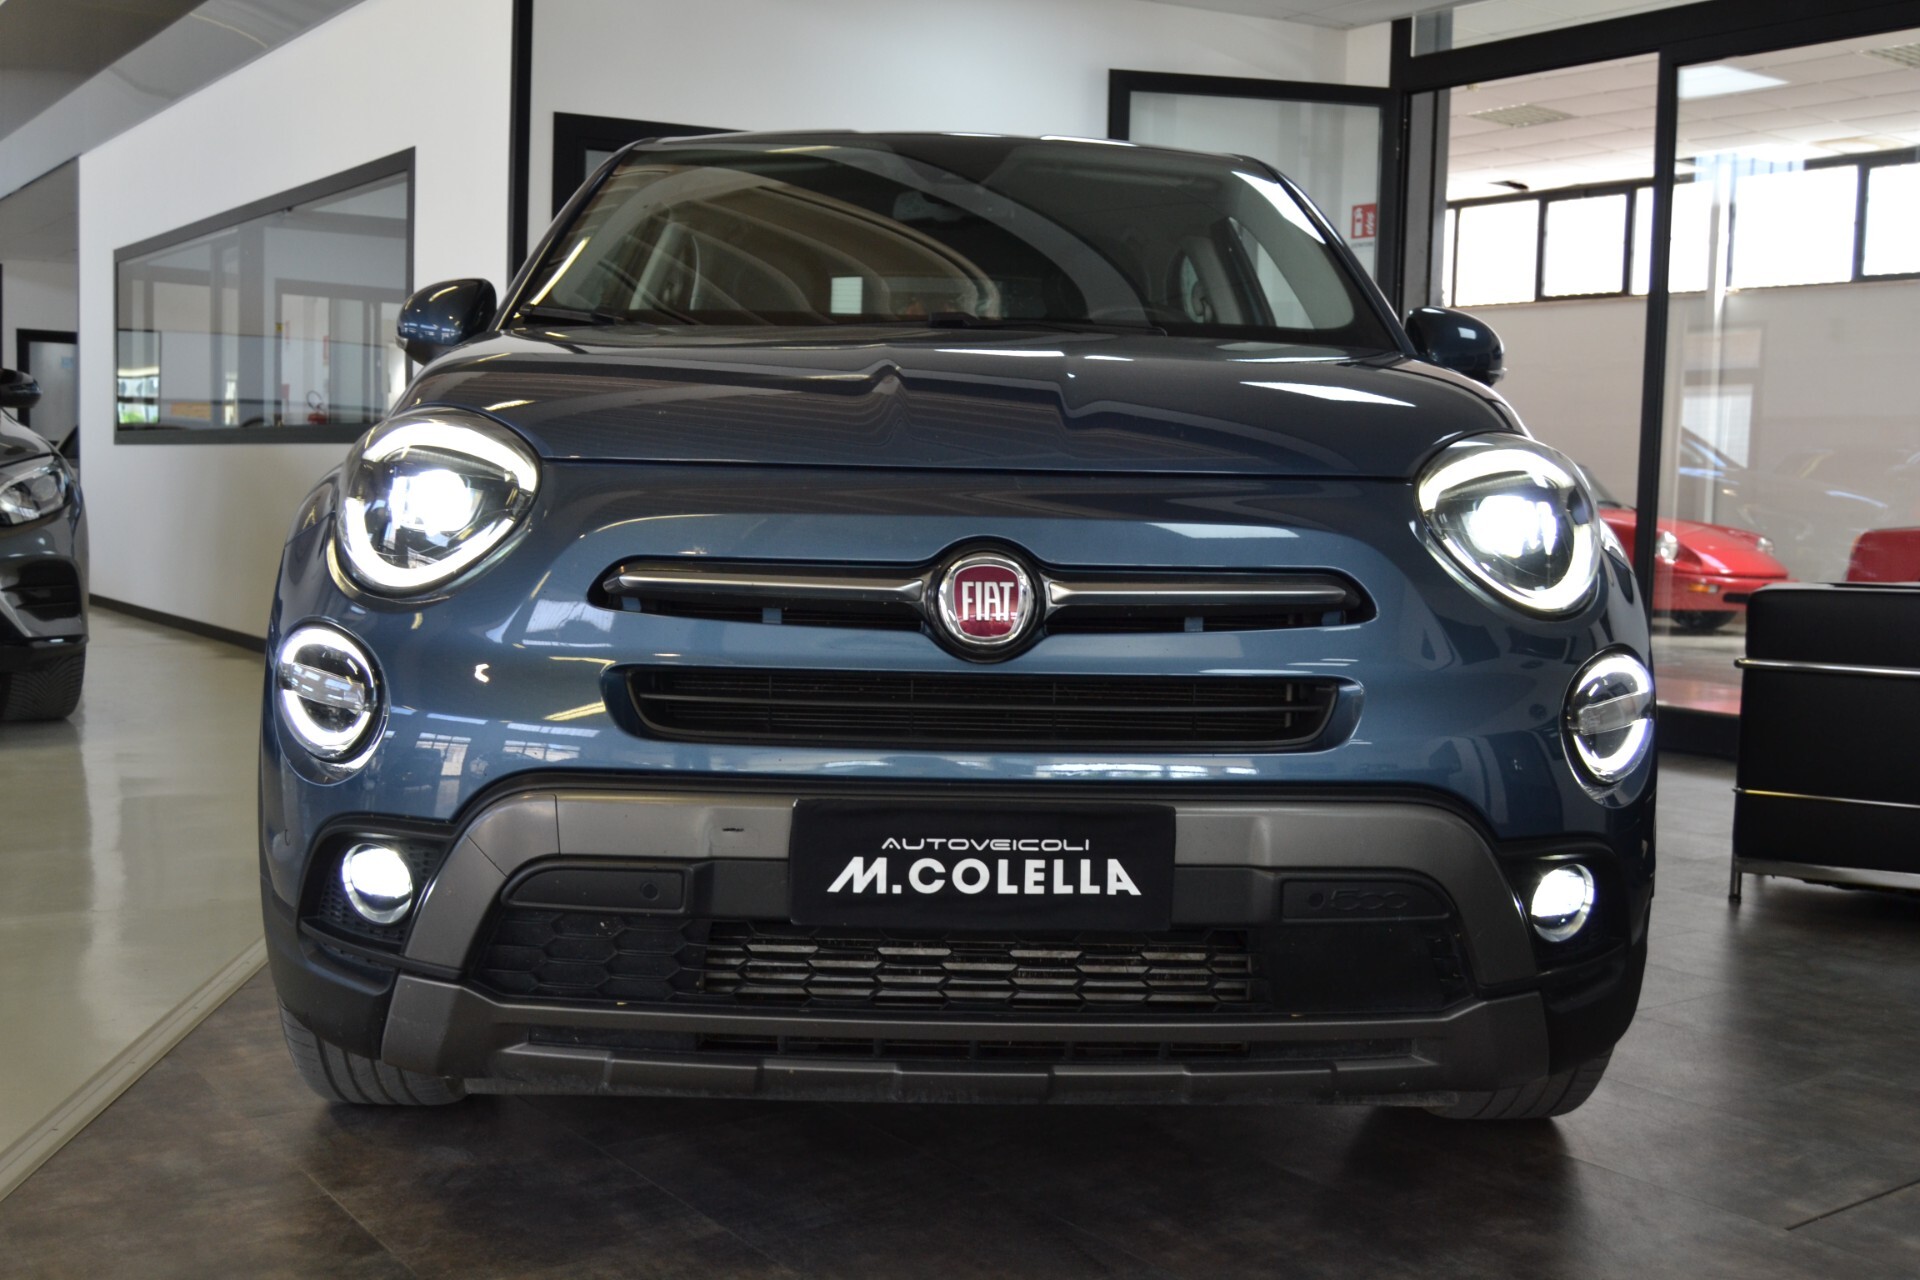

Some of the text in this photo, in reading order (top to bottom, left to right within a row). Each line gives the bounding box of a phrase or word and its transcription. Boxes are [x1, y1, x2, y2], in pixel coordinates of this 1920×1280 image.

[961, 581, 1015, 621] FIAT
[881, 837, 1090, 851] AUTOVEICOLI
[827, 856, 1141, 895] M.COLELLA
[1330, 888, 1408, 911] 500
